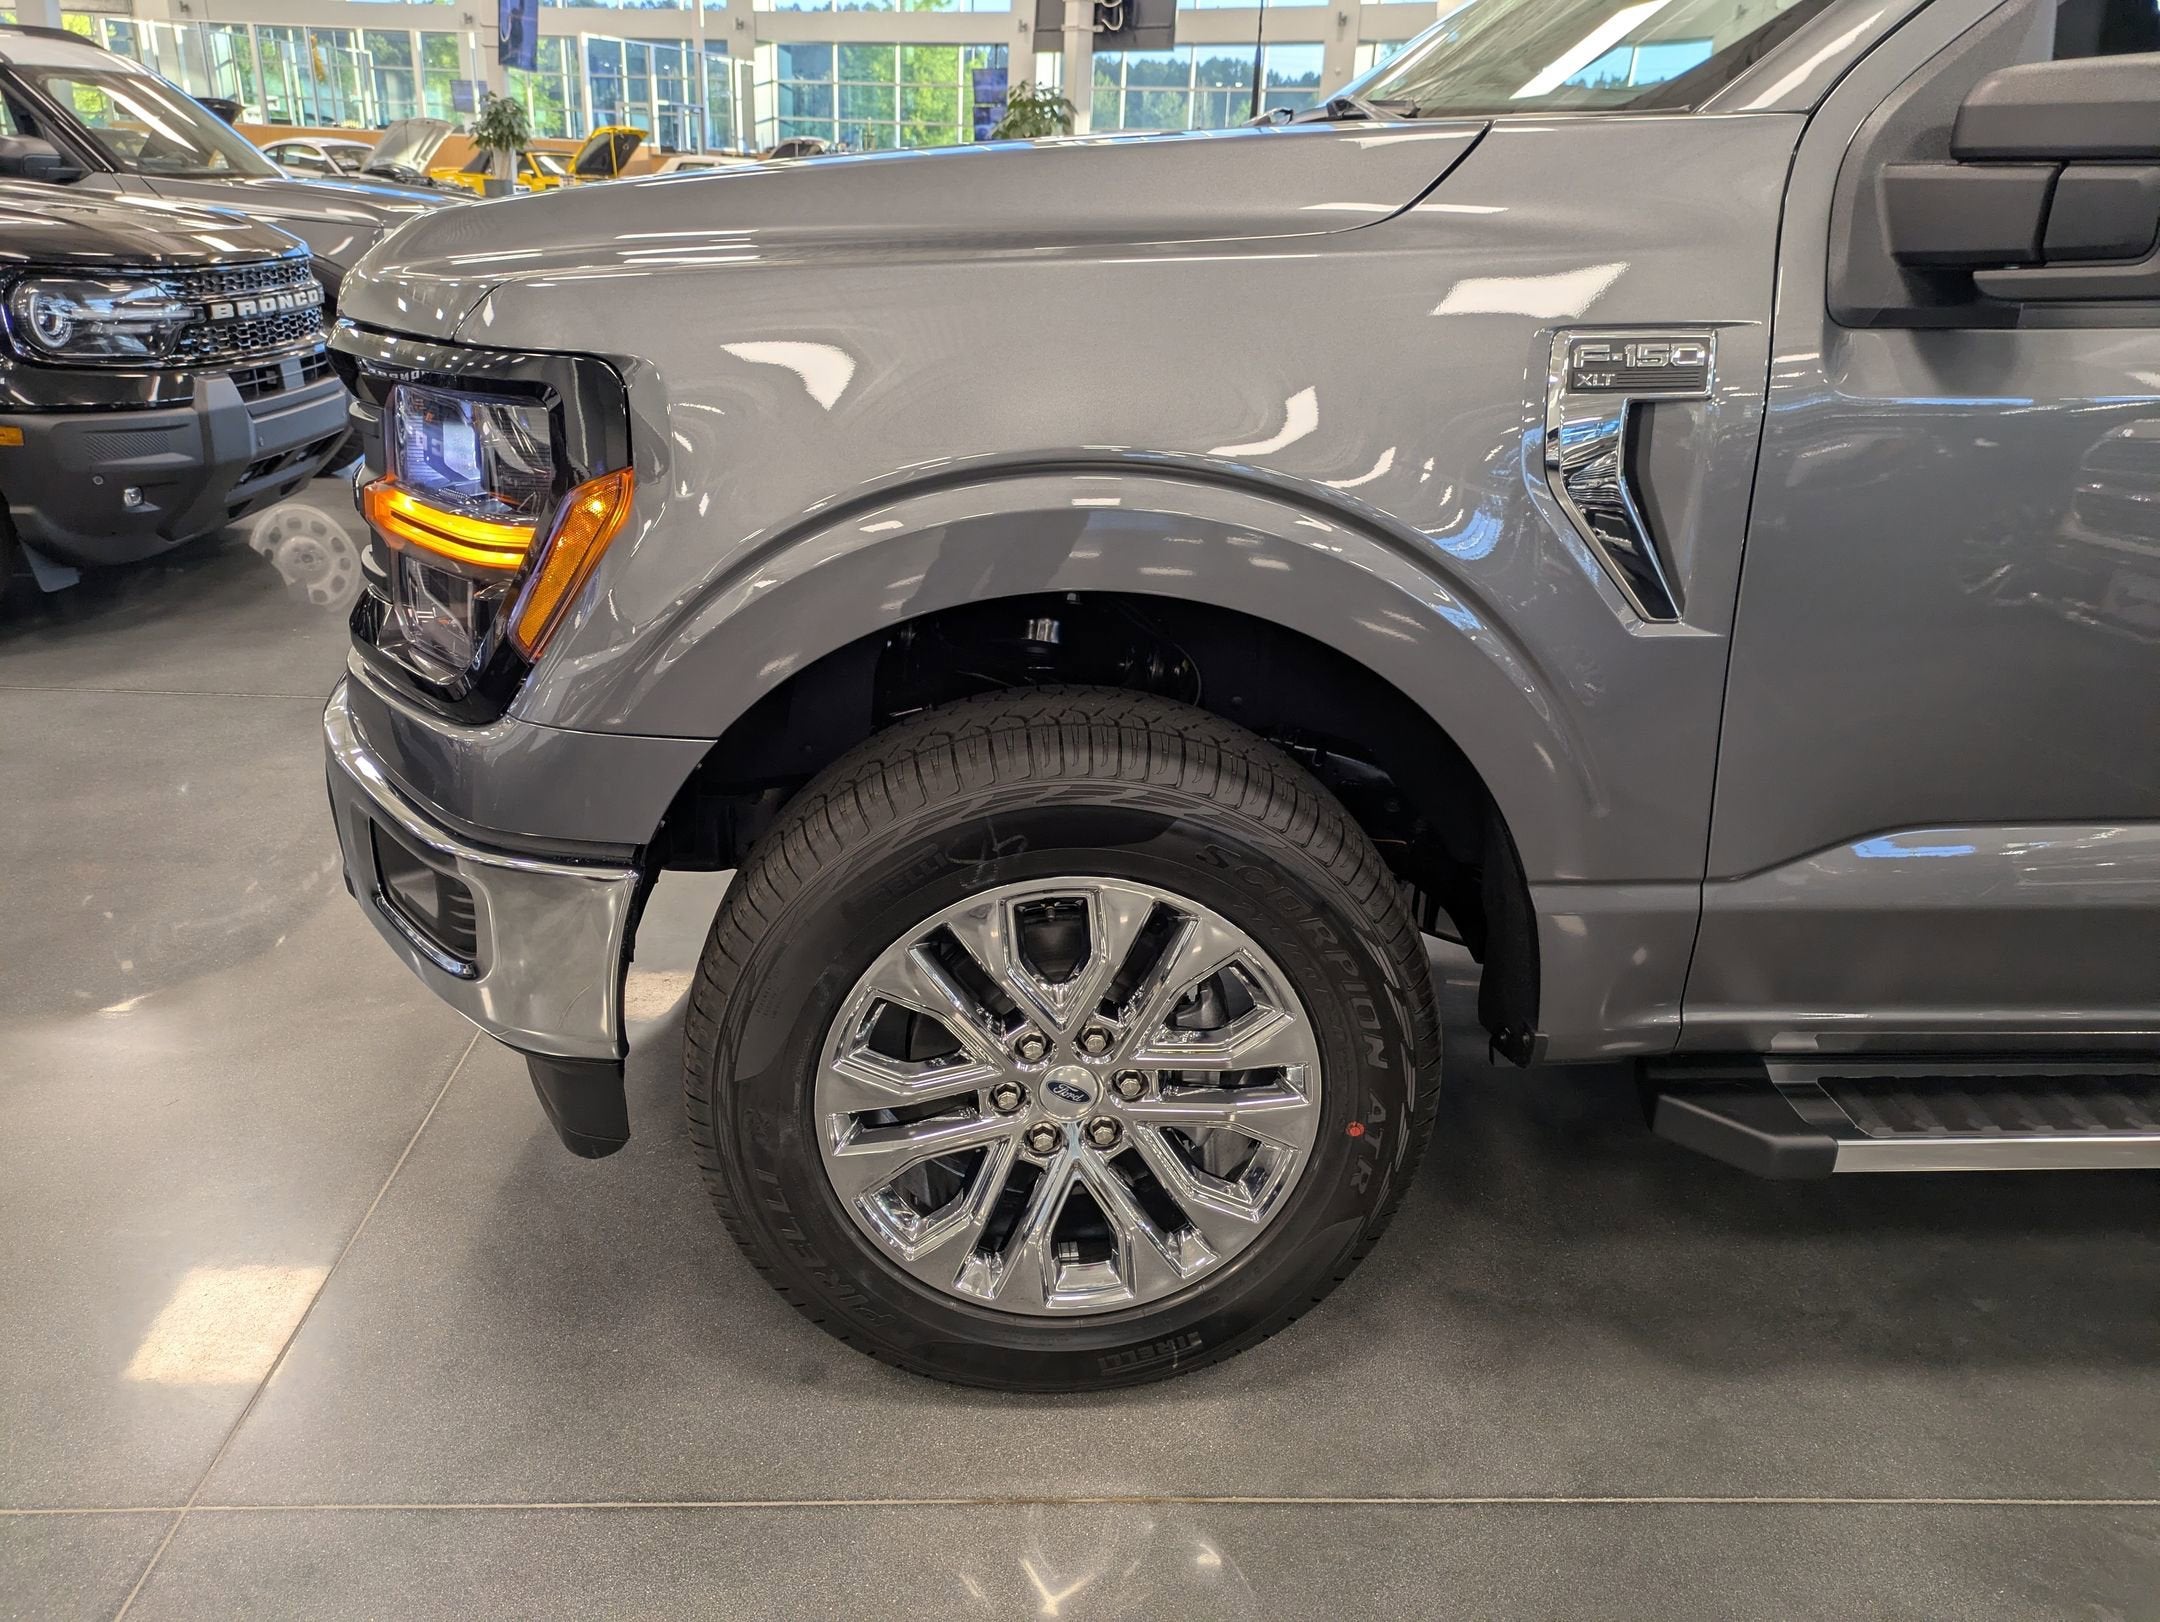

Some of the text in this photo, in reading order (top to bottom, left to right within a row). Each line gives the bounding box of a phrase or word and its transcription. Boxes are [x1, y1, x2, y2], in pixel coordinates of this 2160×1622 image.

[210, 289, 319, 320] BRONCO
[1573, 343, 1705, 369] F-150
[1577, 373, 1615, 387] XLT
[1195, 843, 1389, 1070] SCORPION
[1350, 1087, 1388, 1195] ATR
[1052, 1083, 1085, 1102] Ford
[752, 1167, 897, 1327] PIRELLI
